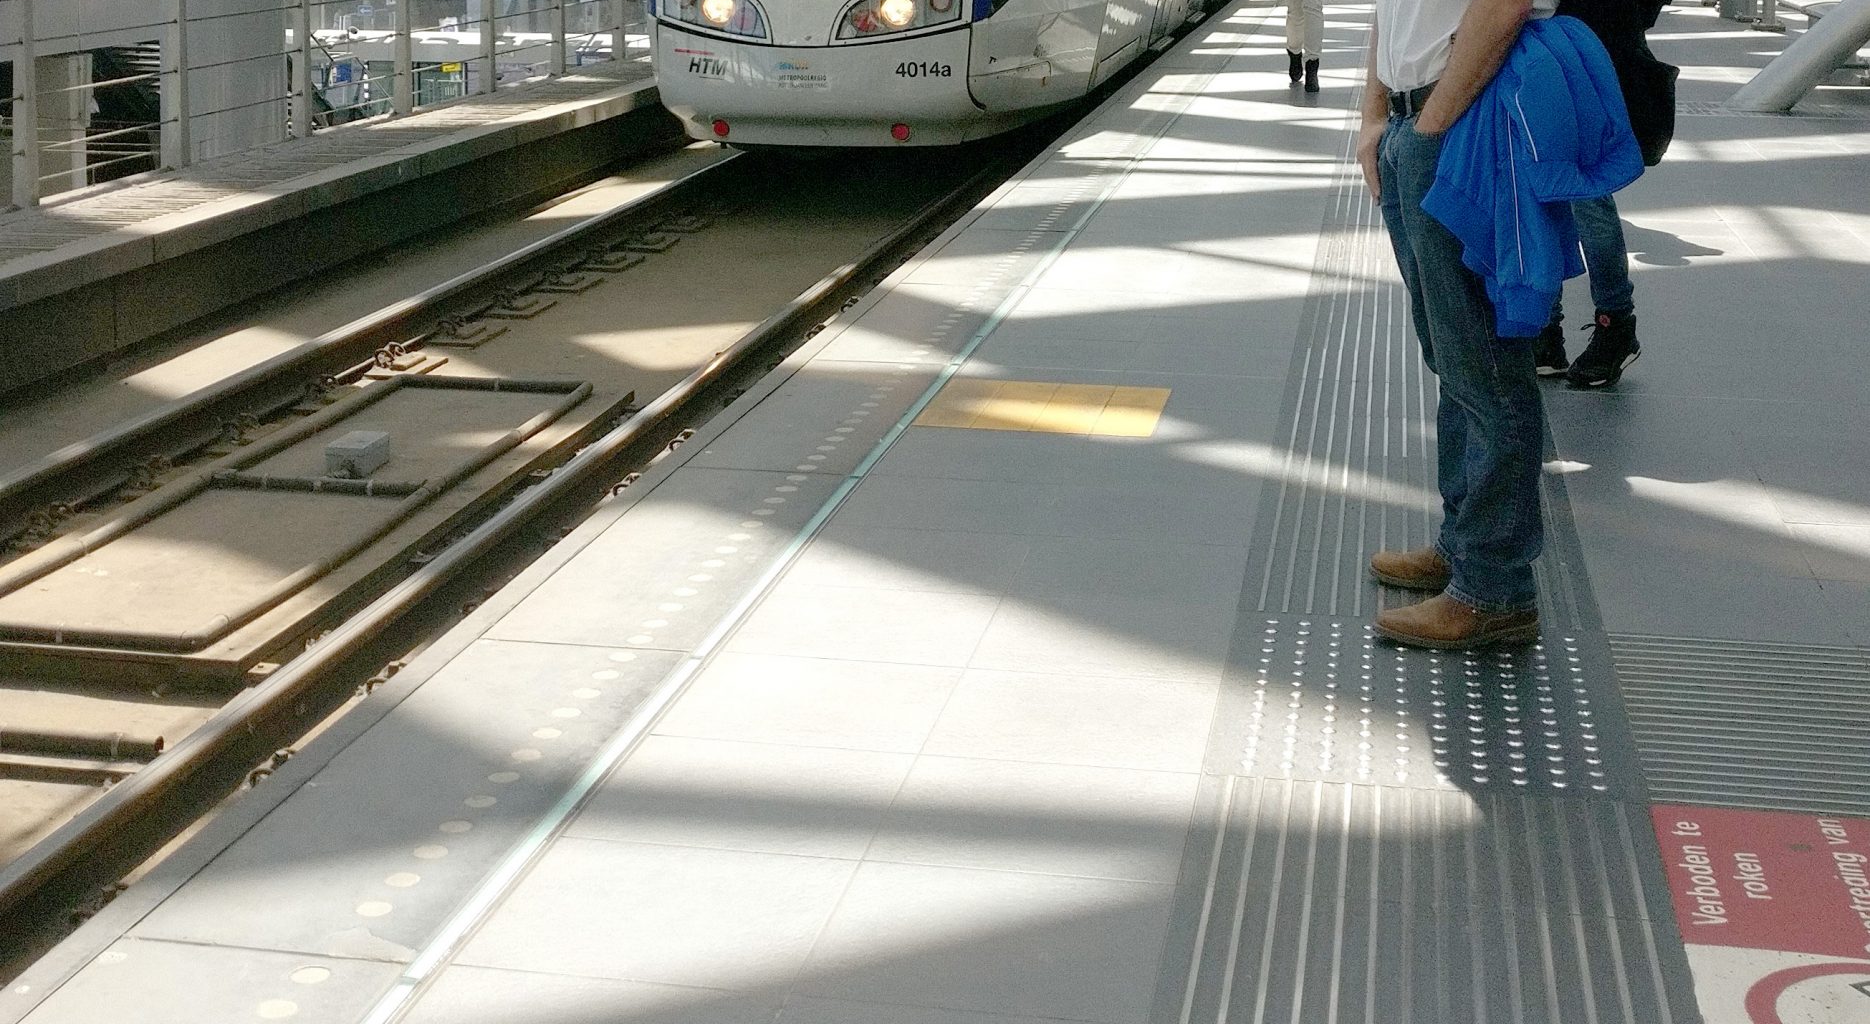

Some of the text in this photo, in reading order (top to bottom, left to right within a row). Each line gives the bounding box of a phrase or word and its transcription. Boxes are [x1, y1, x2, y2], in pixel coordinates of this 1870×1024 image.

[688, 56, 728, 76] HTM
[895, 61, 952, 78] 4014a
[1817, 818, 1850, 845] van
[1671, 821, 1728, 925] Verboden te
[1732, 852, 1773, 899] roken
